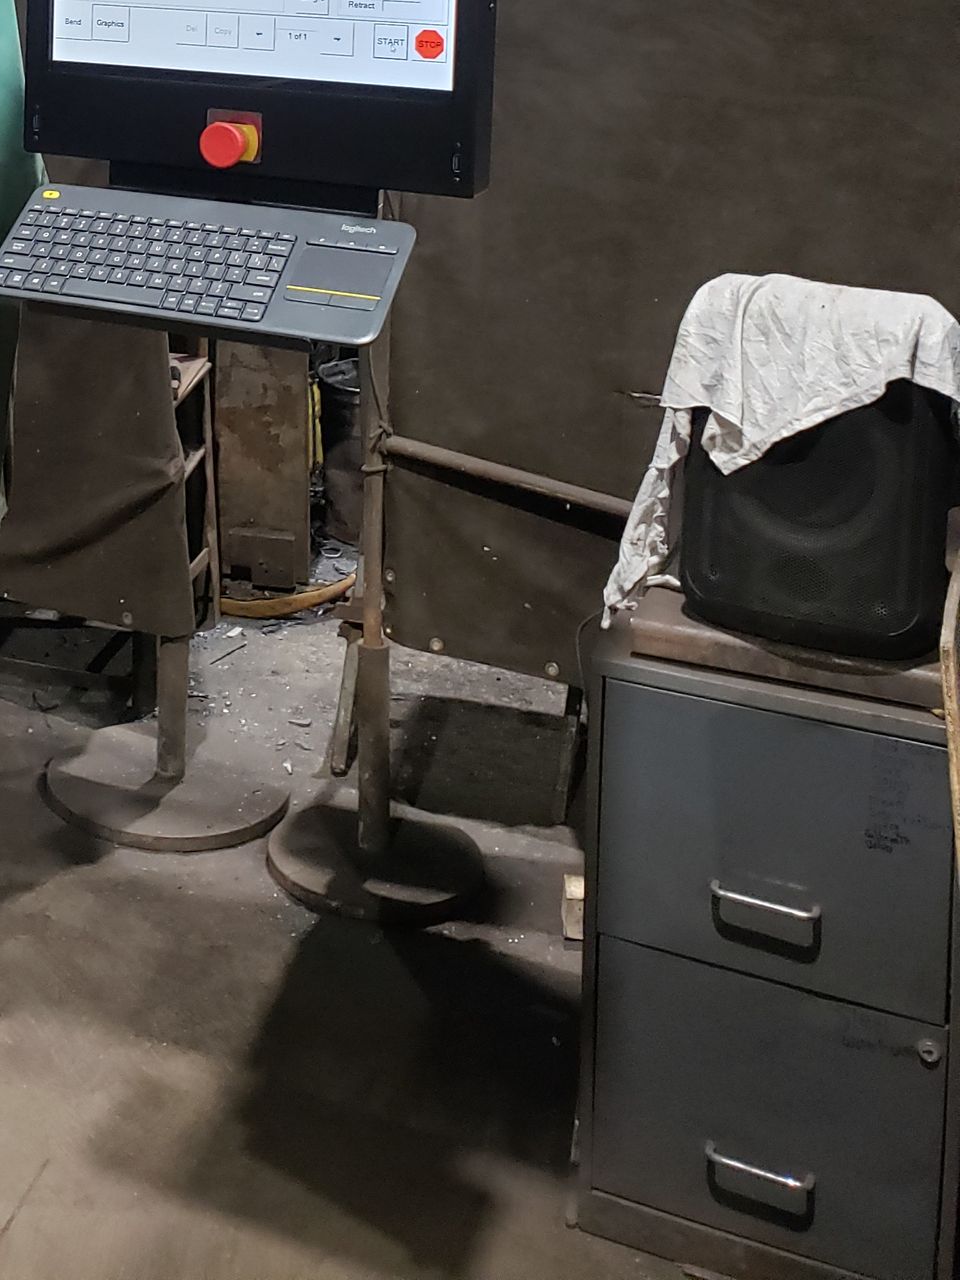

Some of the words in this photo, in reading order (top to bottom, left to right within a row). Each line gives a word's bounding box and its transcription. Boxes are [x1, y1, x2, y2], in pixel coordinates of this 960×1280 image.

[348, 1, 375, 10] Retract
[65, 17, 82, 26] Bend
[96, 19, 125, 29] Graphics
[186, 25, 198, 33] Del
[214, 27, 232, 36] Copy
[377, 37, 405, 47] START
[418, 40, 441, 49] STOP
[341, 223, 377, 235] logitech
